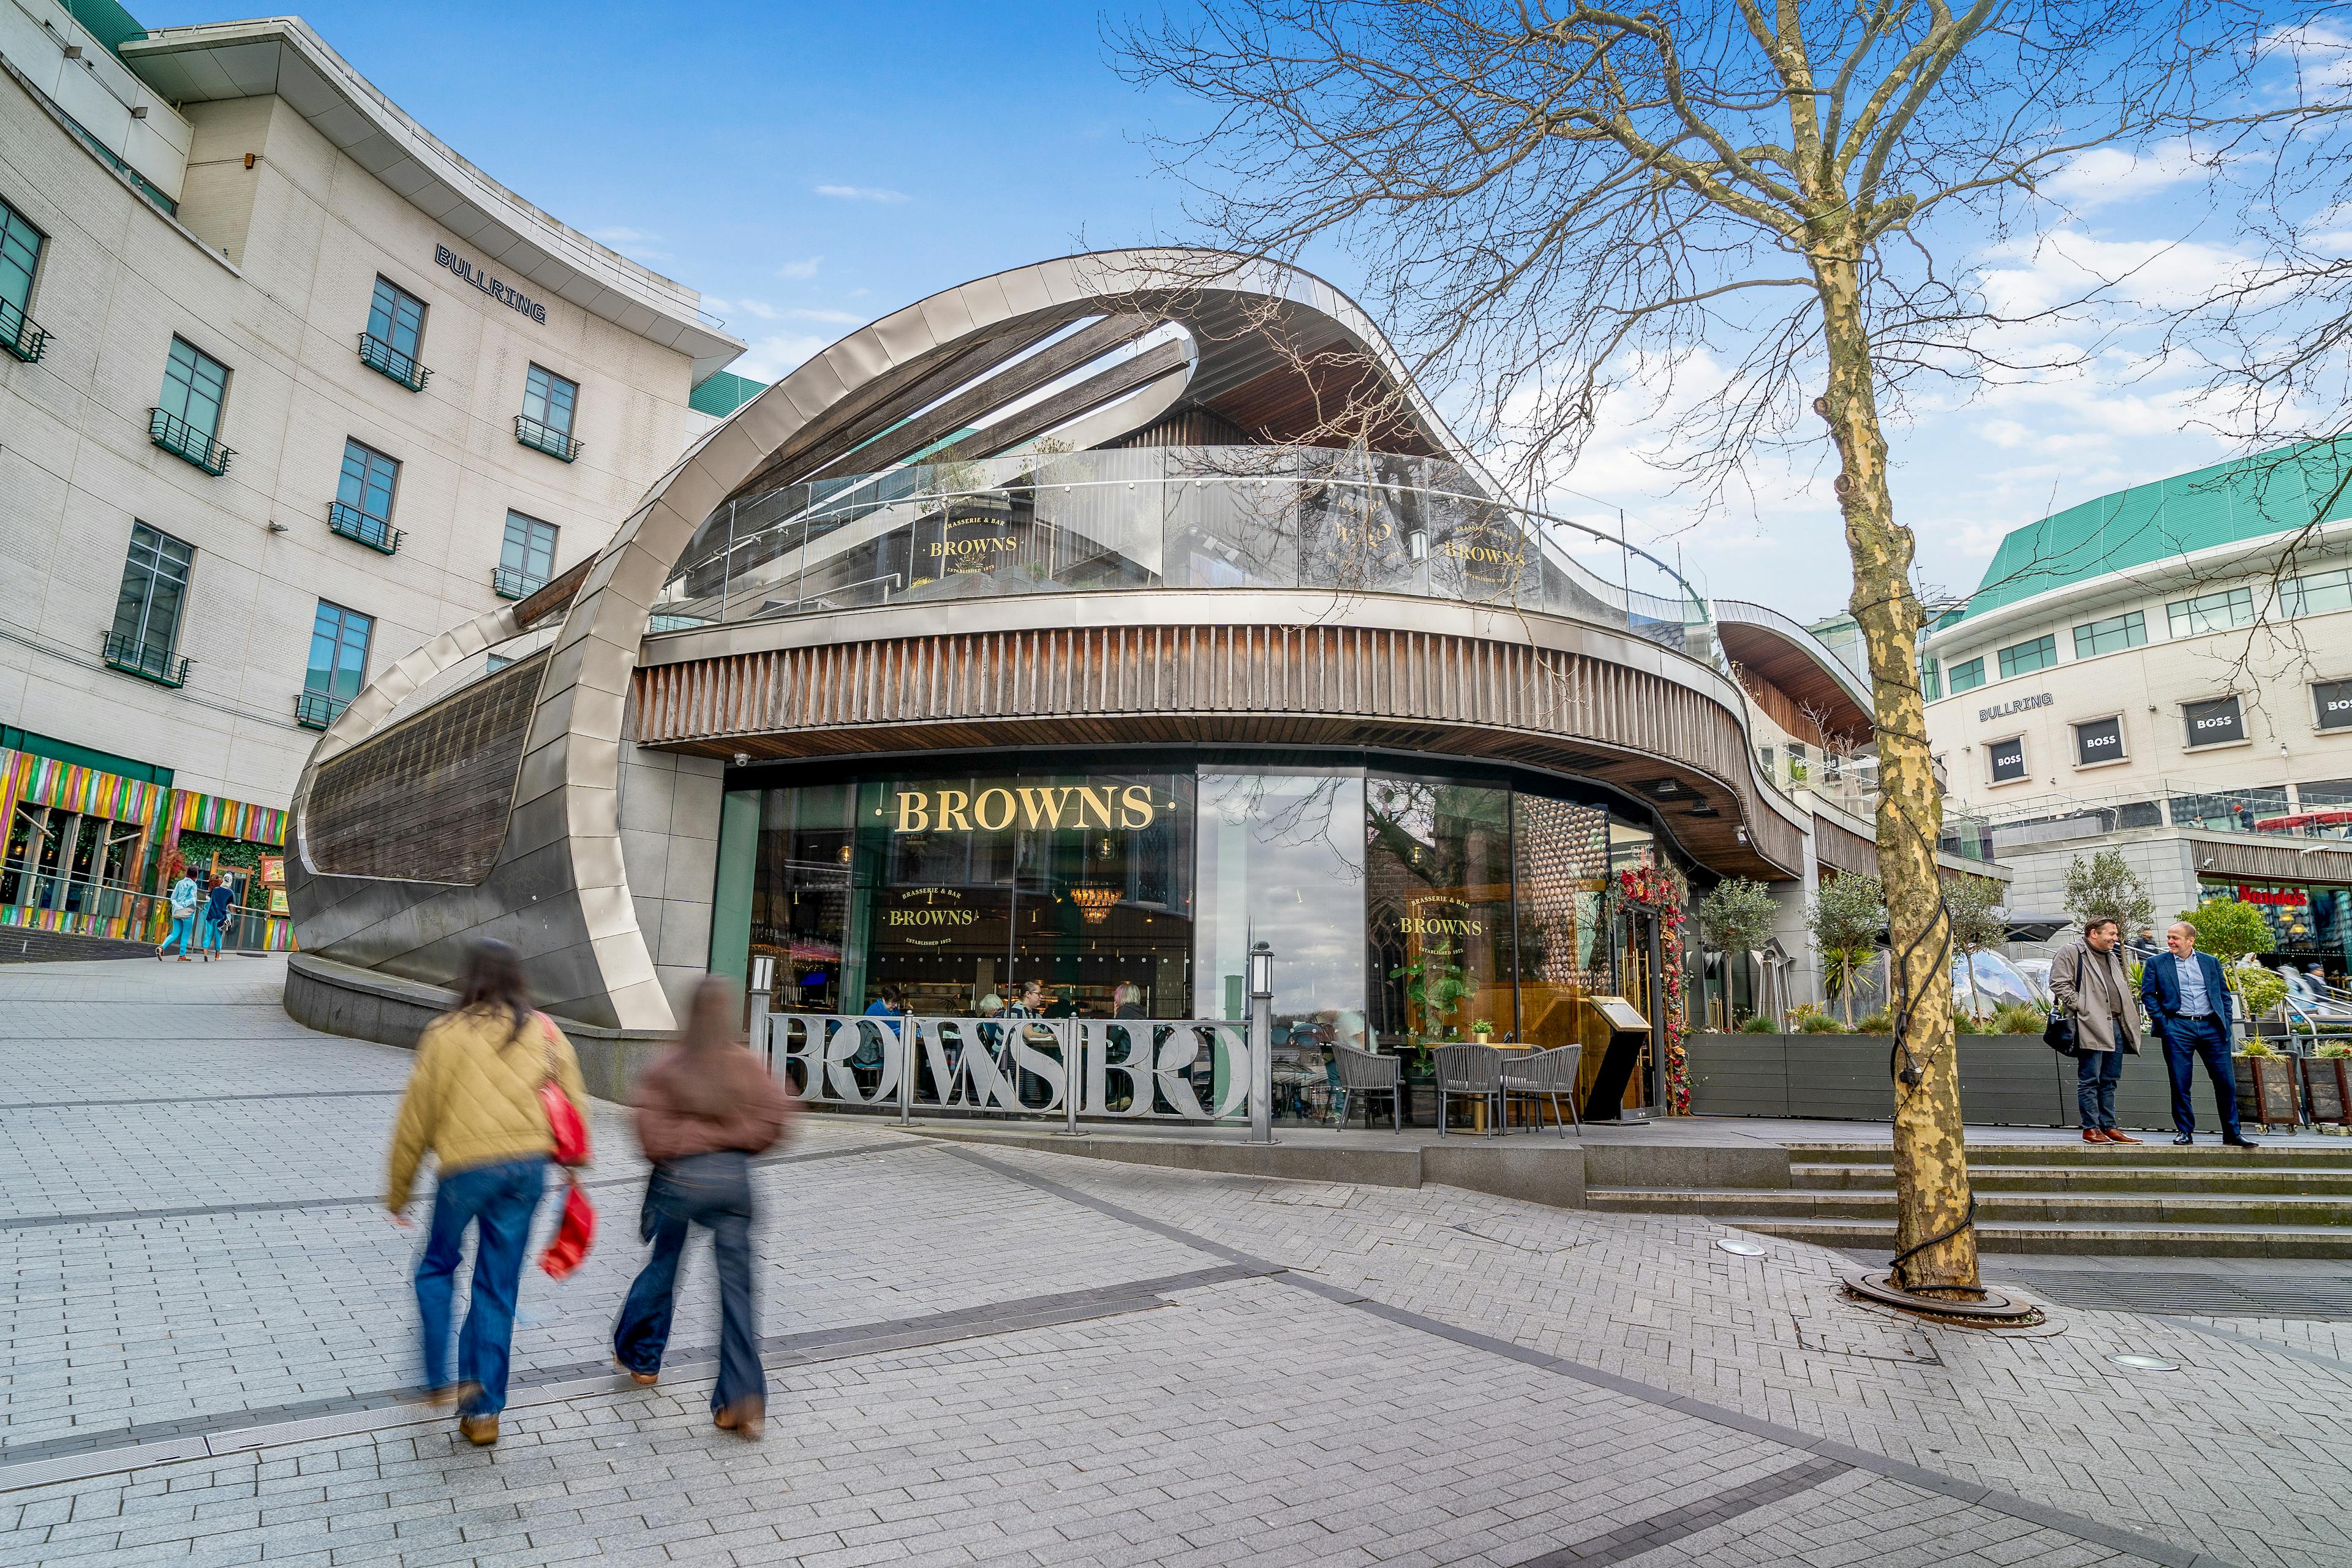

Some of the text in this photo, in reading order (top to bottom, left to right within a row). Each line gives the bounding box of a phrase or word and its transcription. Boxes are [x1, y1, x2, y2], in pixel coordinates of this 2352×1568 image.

[435, 243, 547, 325] BULLRING
[991, 518, 1005, 527] BAR
[1500, 531, 1513, 542] BAR
[929, 536, 1017, 557] BROWNS
[1444, 540, 1526, 568] BROWNS
[1979, 692, 2054, 722] BULLRING
[2197, 716, 2233, 729] BOSS
[2087, 735, 2117, 748] BOSS
[1997, 754, 2021, 767] BOSS
[894, 785, 1155, 834] BROWNS
[902, 888, 938, 900] BRASSERIE
[948, 889, 961, 899] BAR
[2238, 884, 2307, 906] Nando's
[1411, 895, 1447, 907] BRASSERIE
[1457, 899, 1470, 910] BAR
[889, 910, 973, 926] BROWNS
[1400, 917, 1482, 937] BROWNS
[905, 937, 939, 946] ESTABLISHED
[1419, 946, 1452, 956] ESTABLISHED
